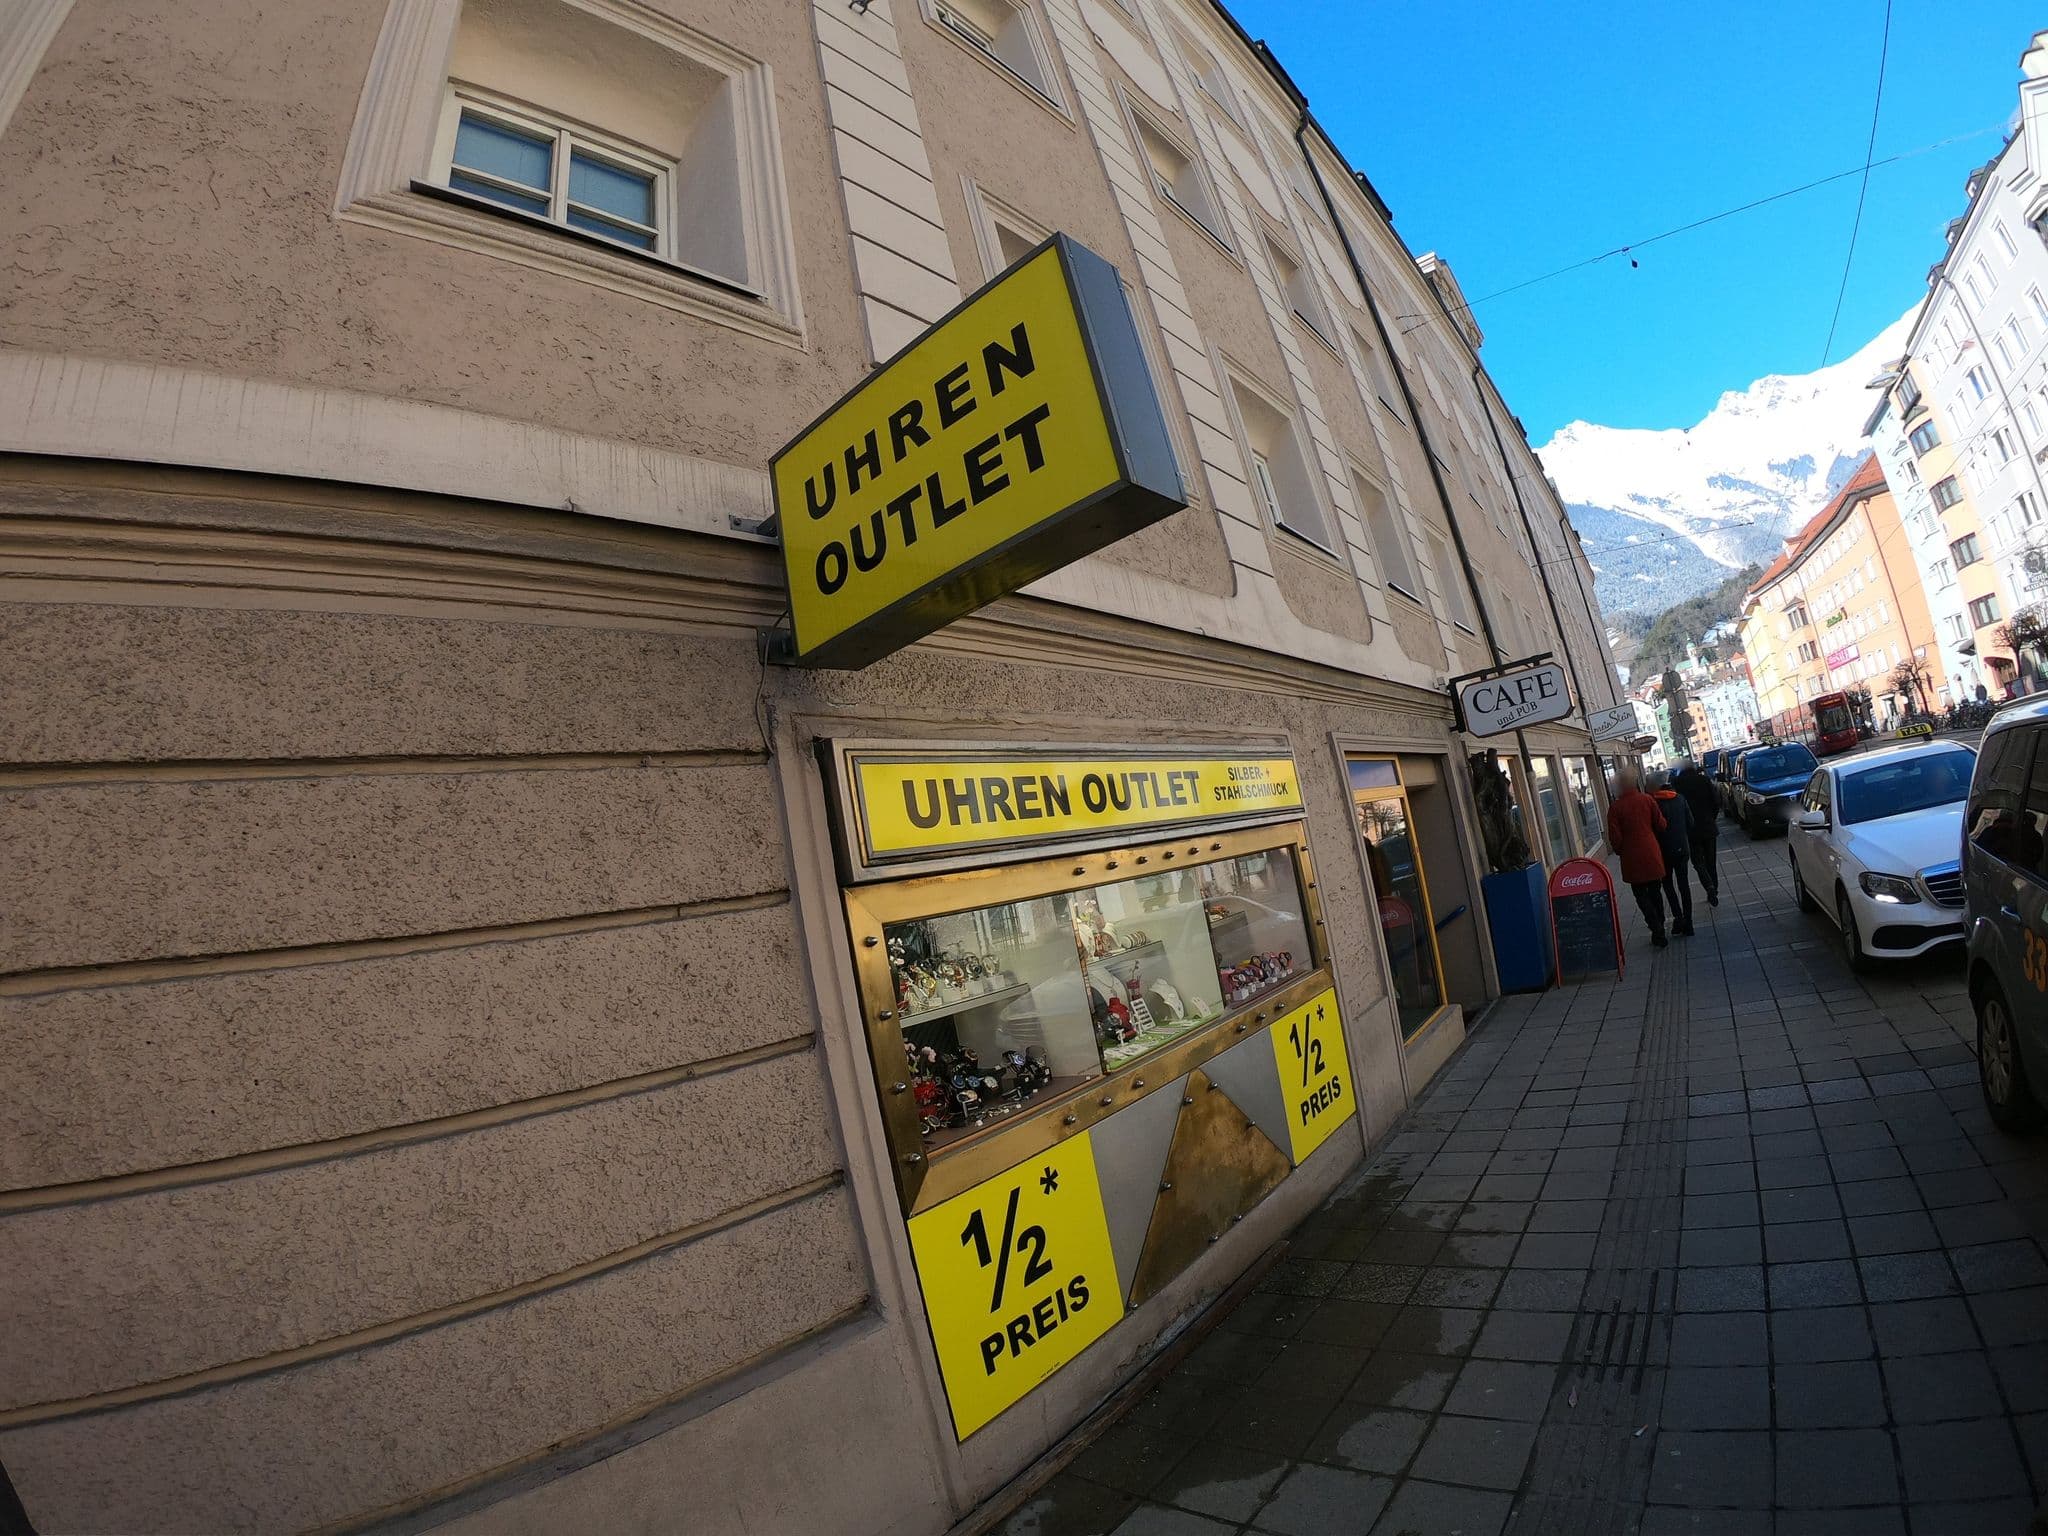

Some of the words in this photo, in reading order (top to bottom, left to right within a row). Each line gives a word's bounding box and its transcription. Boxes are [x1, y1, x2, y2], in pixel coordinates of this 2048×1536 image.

[804, 321, 1036, 521] UHREN
[815, 402, 1051, 596] OUTLET
[1472, 671, 1558, 714] CAFE
[1496, 711, 1516, 726] und
[1517, 701, 1538, 718] PUB
[1902, 723, 1928, 737] TAXI
[901, 774, 1073, 830] UHREN
[1081, 770, 1200, 814] OUTLET
[1213, 782, 1289, 802] STAHLSCHMUCK
[1300, 1075, 1342, 1127] PREIS
[979, 1274, 1090, 1377] PREIS
